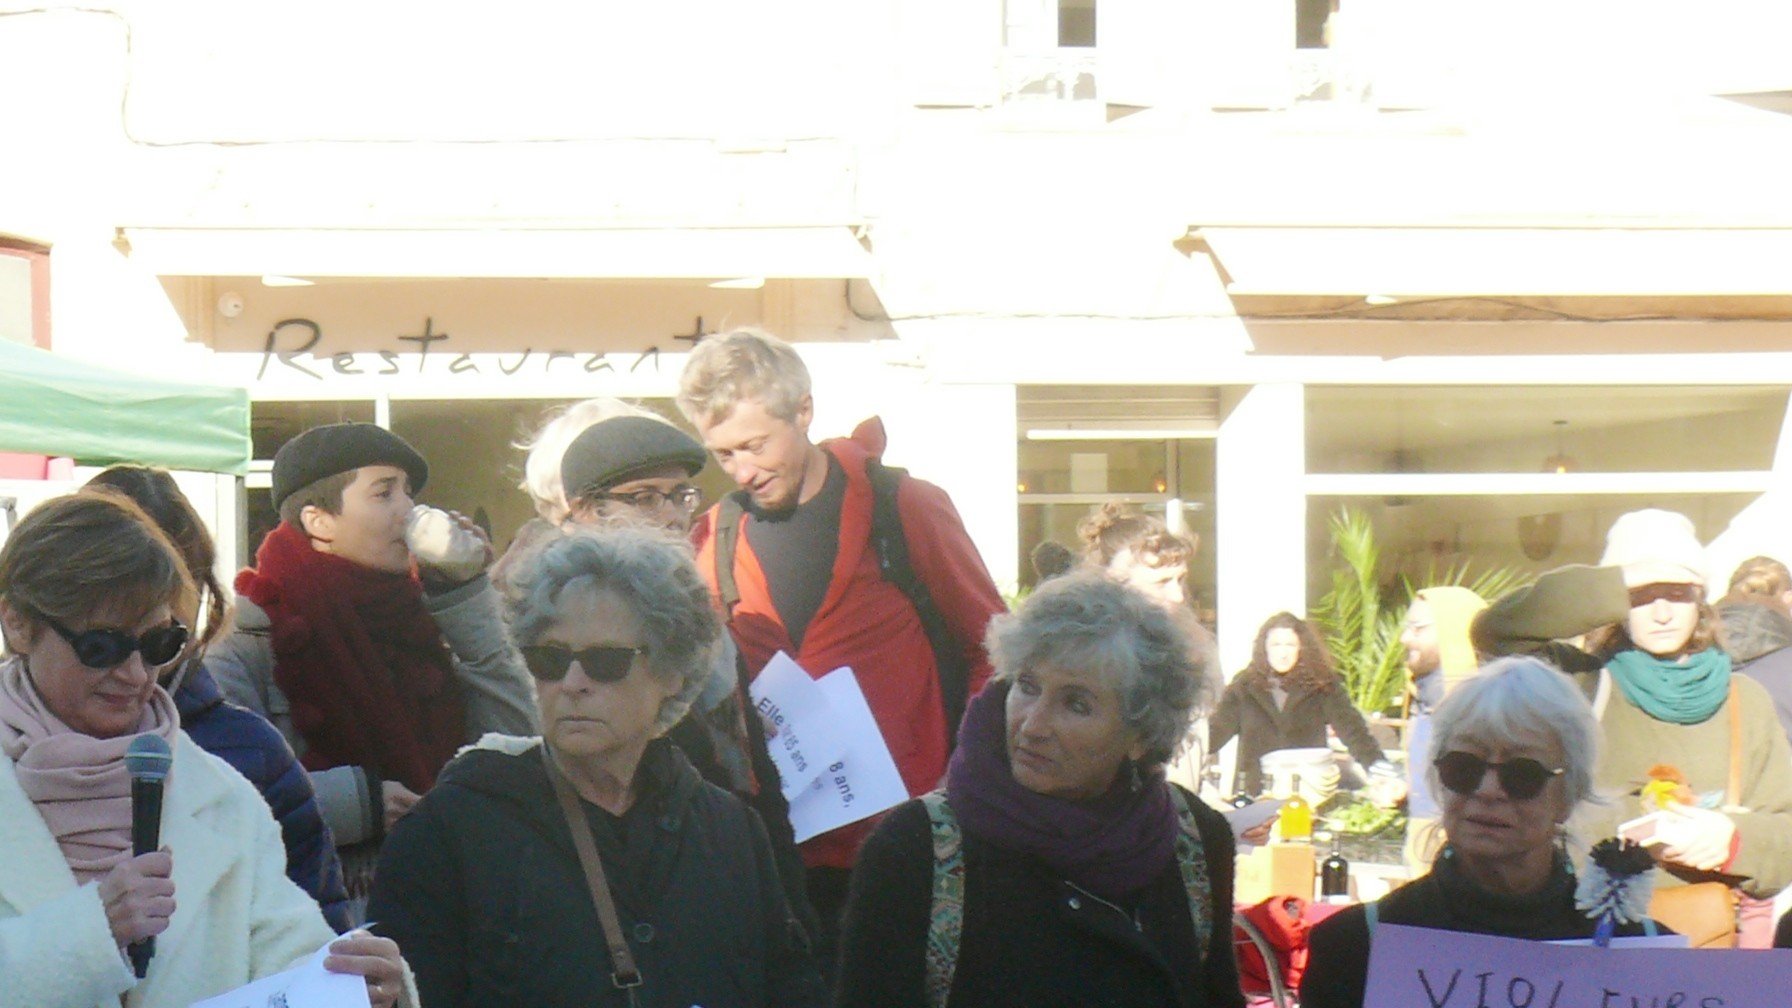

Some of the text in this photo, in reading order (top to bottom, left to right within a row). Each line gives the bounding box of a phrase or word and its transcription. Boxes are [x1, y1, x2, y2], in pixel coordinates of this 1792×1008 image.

[257, 316, 716, 380] Restaurant
[757, 698, 784, 726] Elle
[790, 750, 808, 773] ans
[834, 775, 855, 808] ans,
